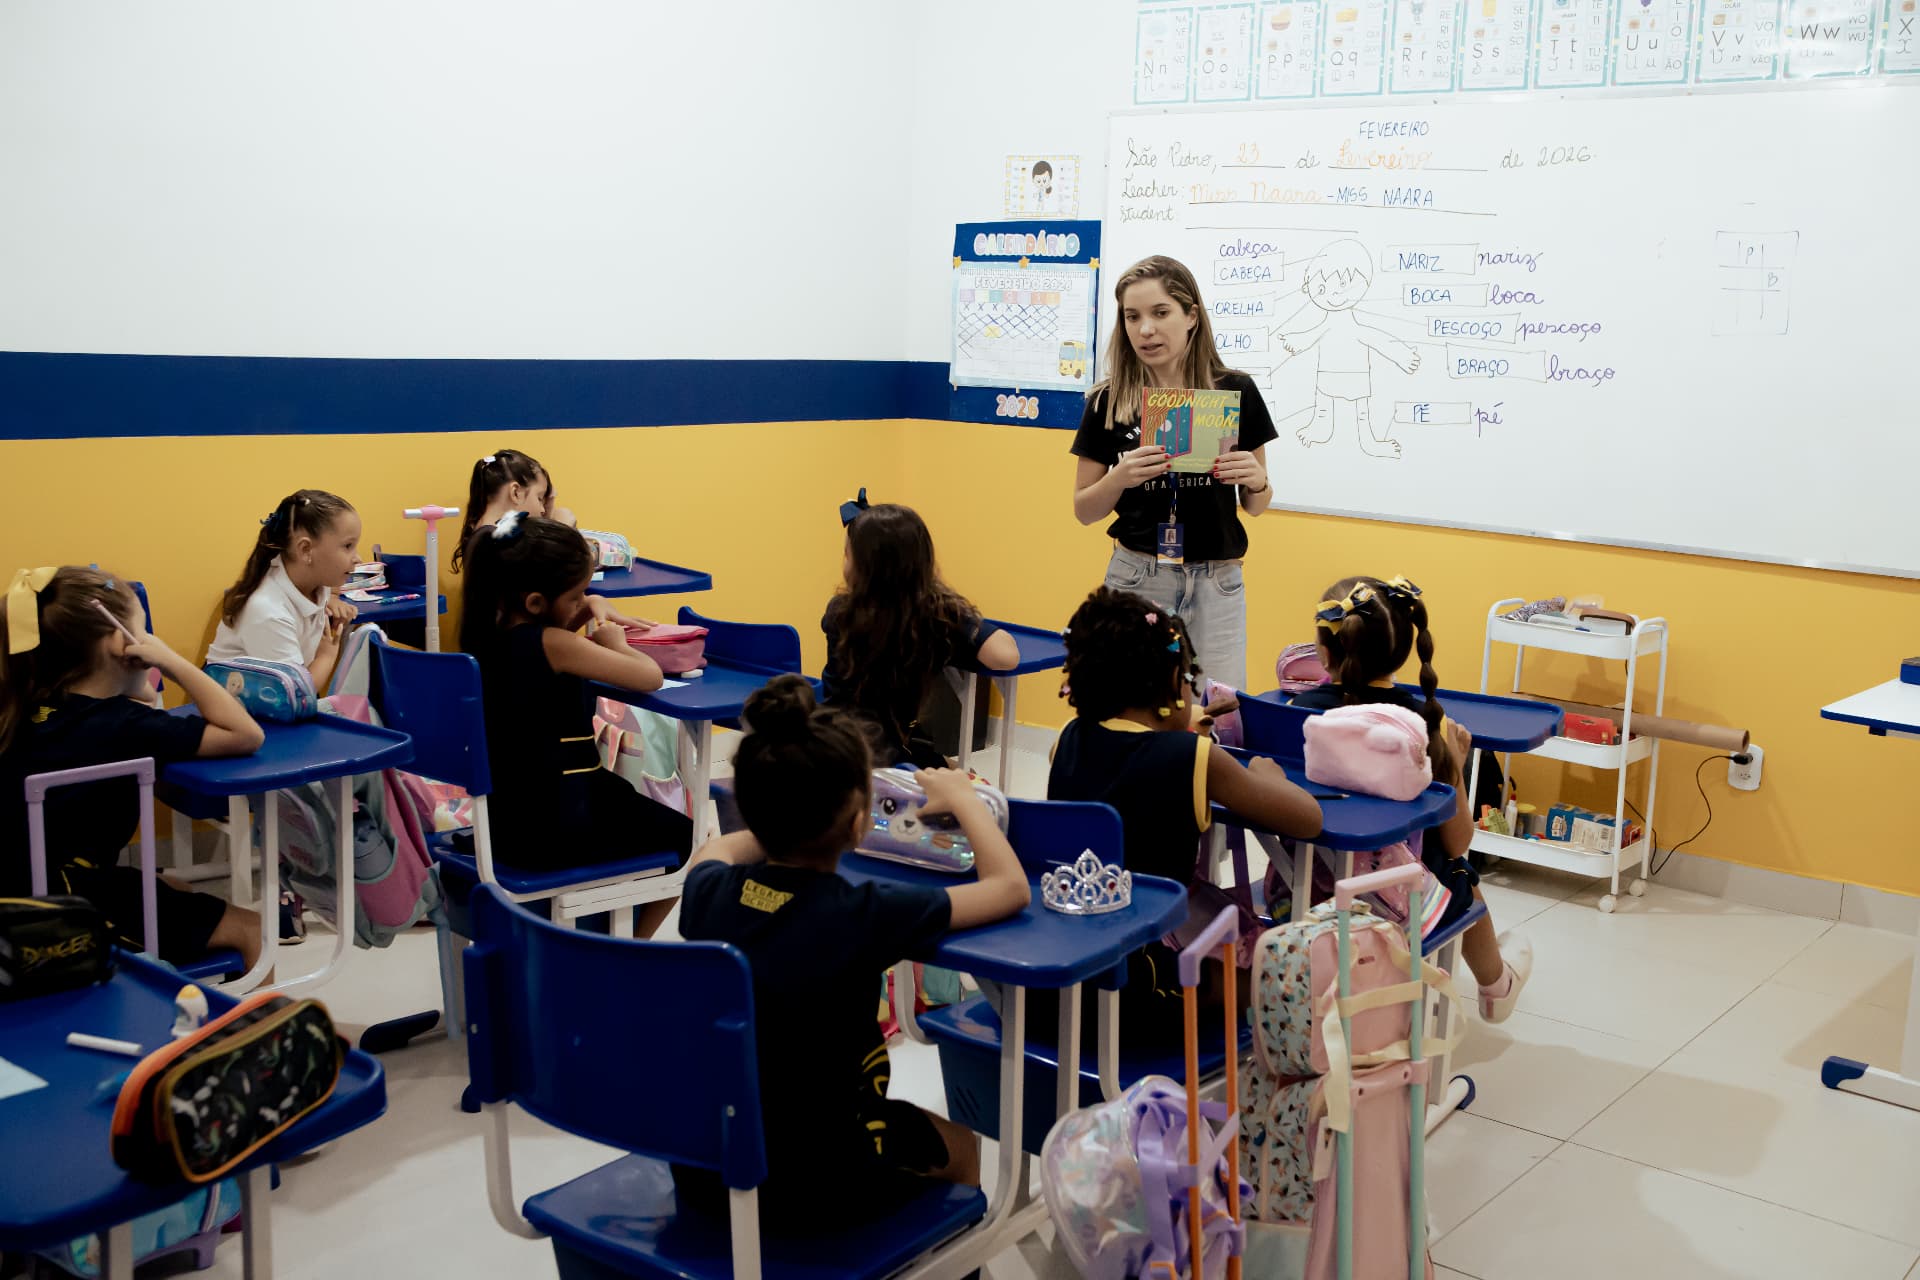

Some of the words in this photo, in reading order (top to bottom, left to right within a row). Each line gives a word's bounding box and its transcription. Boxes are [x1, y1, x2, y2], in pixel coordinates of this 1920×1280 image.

[1800, 23, 1819, 40] W
[1898, 17, 1914, 36] X
[1626, 35, 1639, 51] U
[1711, 30, 1726, 47] V
[1330, 51, 1344, 66] Q
[1402, 47, 1412, 62] R
[1471, 43, 1484, 59] S
[1143, 60, 1154, 76] N
[1202, 60, 1215, 75] O
[1359, 120, 1430, 140] FEVEREIRO
[1125, 137, 1158, 169] São
[1295, 148, 1320, 168] de
[1500, 149, 1524, 169] de
[1384, 187, 1433, 208] NAARA
[1219, 238, 1278, 258] cabeça
[1399, 252, 1444, 272] NARIZ
[1479, 247, 1543, 272] nariz
[1219, 266, 1272, 281] CABEÇA
[1411, 289, 1451, 305] BOCA
[1490, 284, 1544, 305] boca
[1215, 302, 1264, 316] ORELHA
[1434, 319, 1501, 340] PESCOÇO
[1516, 321, 1602, 343] pescoço
[1214, 334, 1252, 350] OLHO
[1457, 359, 1509, 379] BRAÇO
[1546, 354, 1616, 388] braço
[996, 394, 1040, 420] 2026
[1147, 392, 1229, 409] GOODNIGHT
[1194, 413, 1235, 428] MOON
[1474, 402, 1504, 438] pé
[1144, 481, 1157, 491] OF
[1160, 476, 1212, 489] AERICA
